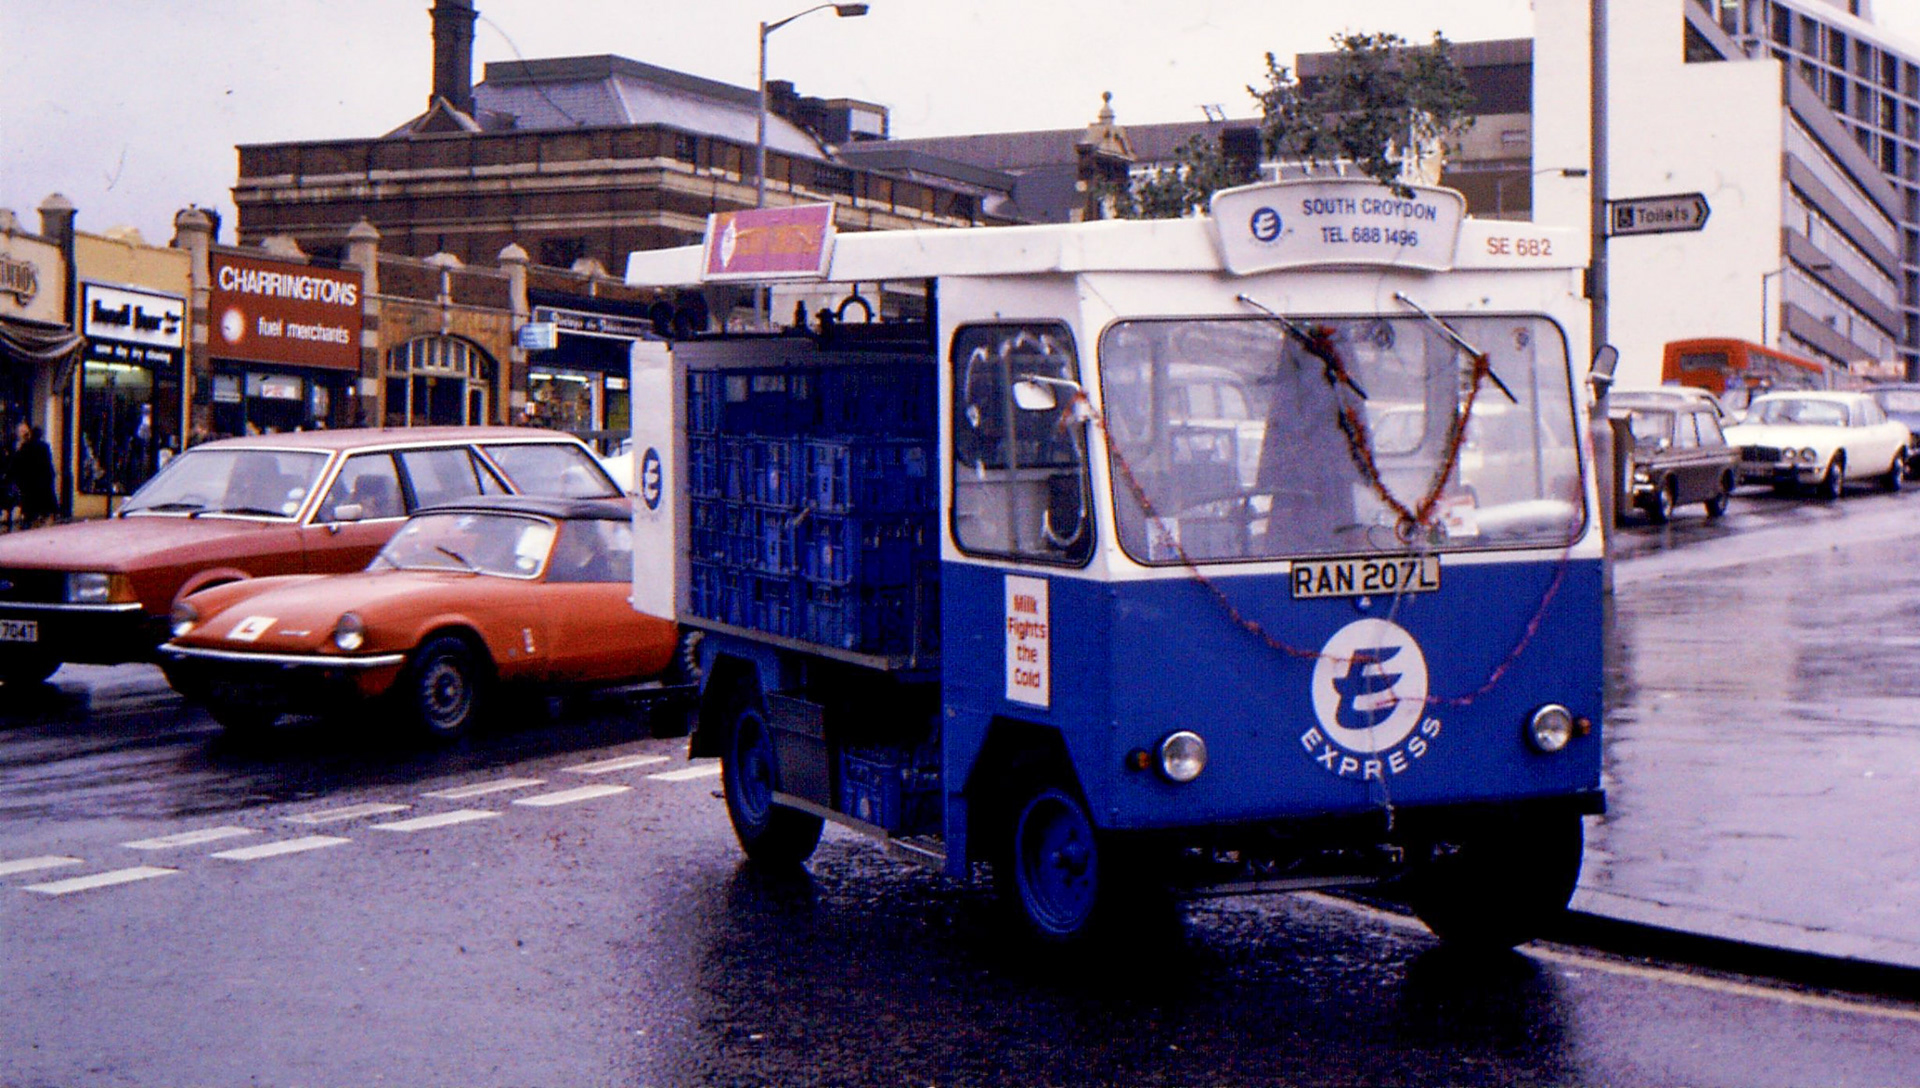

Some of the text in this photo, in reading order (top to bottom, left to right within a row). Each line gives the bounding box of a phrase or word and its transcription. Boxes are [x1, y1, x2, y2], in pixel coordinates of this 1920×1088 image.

[1302, 199, 1436, 220] SOUTH CROYDON
[1637, 205, 1689, 223] Toilets
[1321, 227, 1418, 246] TEL. 688 1496
[1487, 237, 1552, 256] SE 682
[218, 265, 358, 306] CHARRINGTONS
[258, 316, 350, 344] fuel merchants
[1294, 561, 1437, 594] RAN 207L
[1013, 594, 1037, 614] Milk
[1008, 617, 1046, 640] Fights
[1016, 645, 1037, 662] the
[1014, 667, 1040, 688] Cold
[1300, 717, 1441, 780] EXPRESS
